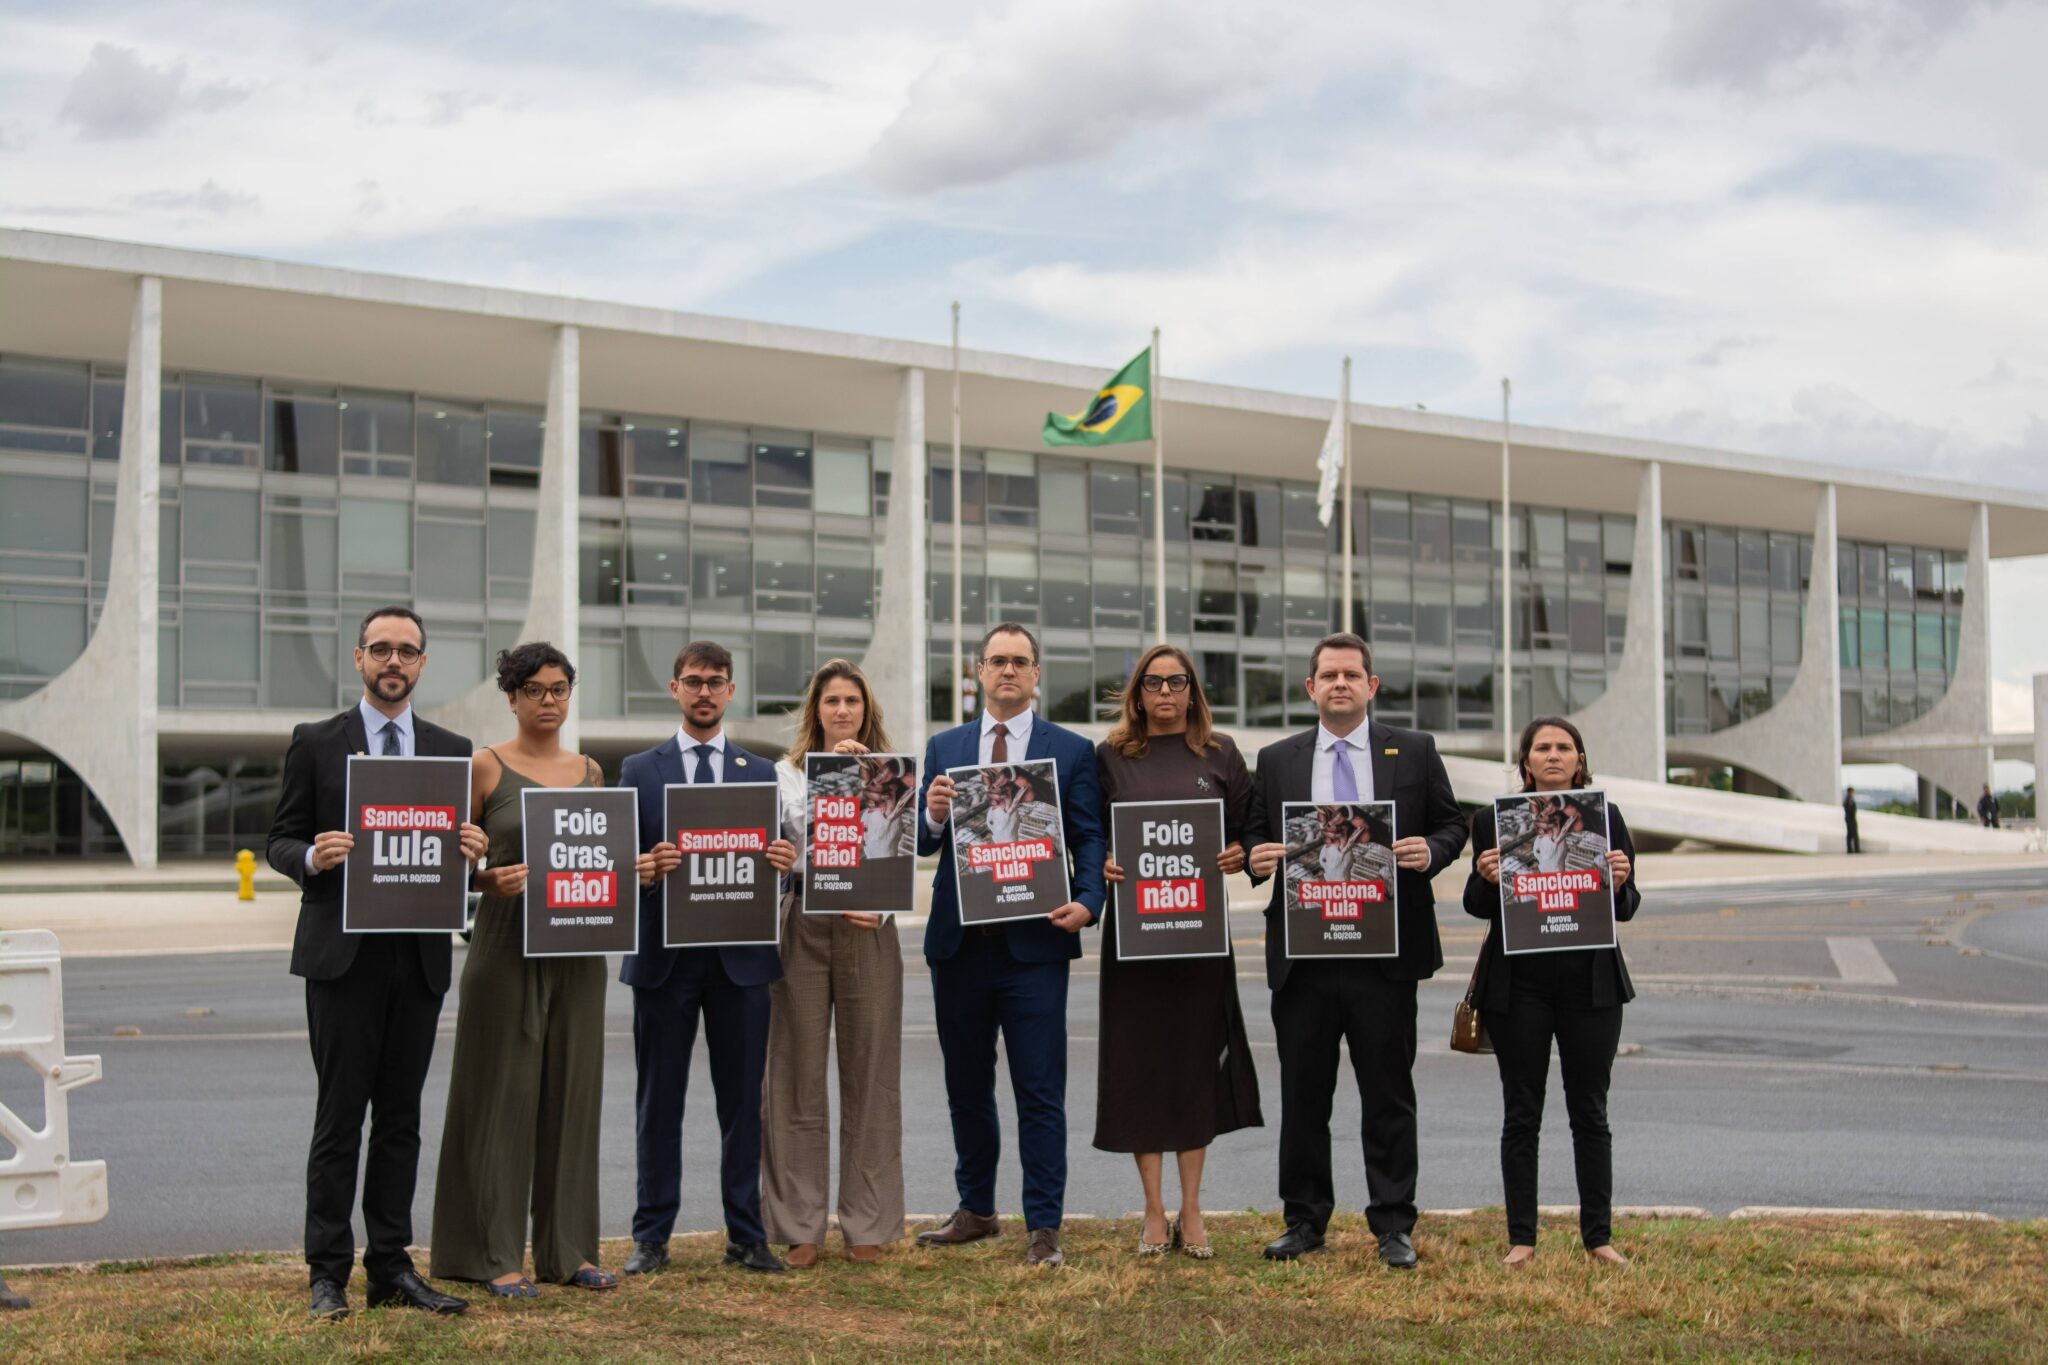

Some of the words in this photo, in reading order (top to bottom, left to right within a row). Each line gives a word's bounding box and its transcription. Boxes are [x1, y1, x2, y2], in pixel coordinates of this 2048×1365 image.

[816, 798, 856, 818] Foie
[365, 807, 452, 830] Sanciona,
[554, 808, 608, 836] Foie
[681, 831, 764, 850] Sanciona,
[816, 822, 863, 844] Gras,
[1142, 820, 1194, 846] Foie
[373, 830, 442, 866] Lula
[550, 842, 615, 872] Gras,
[816, 844, 856, 866] não!
[971, 842, 1050, 864] Sanciona,
[690, 852, 755, 886] Lula
[995, 860, 1029, 880] Lula
[1138, 852, 1201, 879] Gras,
[373, 874, 399, 883] Aprova
[400, 874, 409, 883] PL
[409, 873, 441, 884] 90/2020
[814, 873, 840, 882] Aprova
[814, 882, 823, 890] PL
[823, 881, 853, 890] 90/2020
[1517, 873, 1597, 893] Sanciona,
[554, 872, 610, 904] não!
[690, 892, 715, 901] Aprova
[716, 892, 724, 900] PL
[725, 891, 754, 901] 90/2020
[996, 895, 1005, 903] PL
[1006, 891, 1034, 903] 90/2020
[1002, 884, 1027, 894] Aprova
[1143, 880, 1198, 909] não!
[1302, 882, 1382, 901] Sanciona,
[1325, 900, 1358, 917] Lula
[1541, 890, 1574, 909] Lula
[550, 917, 575, 926] Aprova
[576, 917, 584, 925] PL
[585, 916, 614, 926] 90/2020
[1141, 922, 1166, 931] Aprova
[1166, 921, 1174, 929] PL
[1175, 920, 1203, 929] 90/2020
[1330, 923, 1355, 932] Aprova
[1540, 925, 1550, 933] PL
[1550, 922, 1579, 933] 90/2020
[1546, 915, 1572, 924] Aprova
[1324, 932, 1332, 940] PL
[1333, 931, 1362, 940] 90/2020
